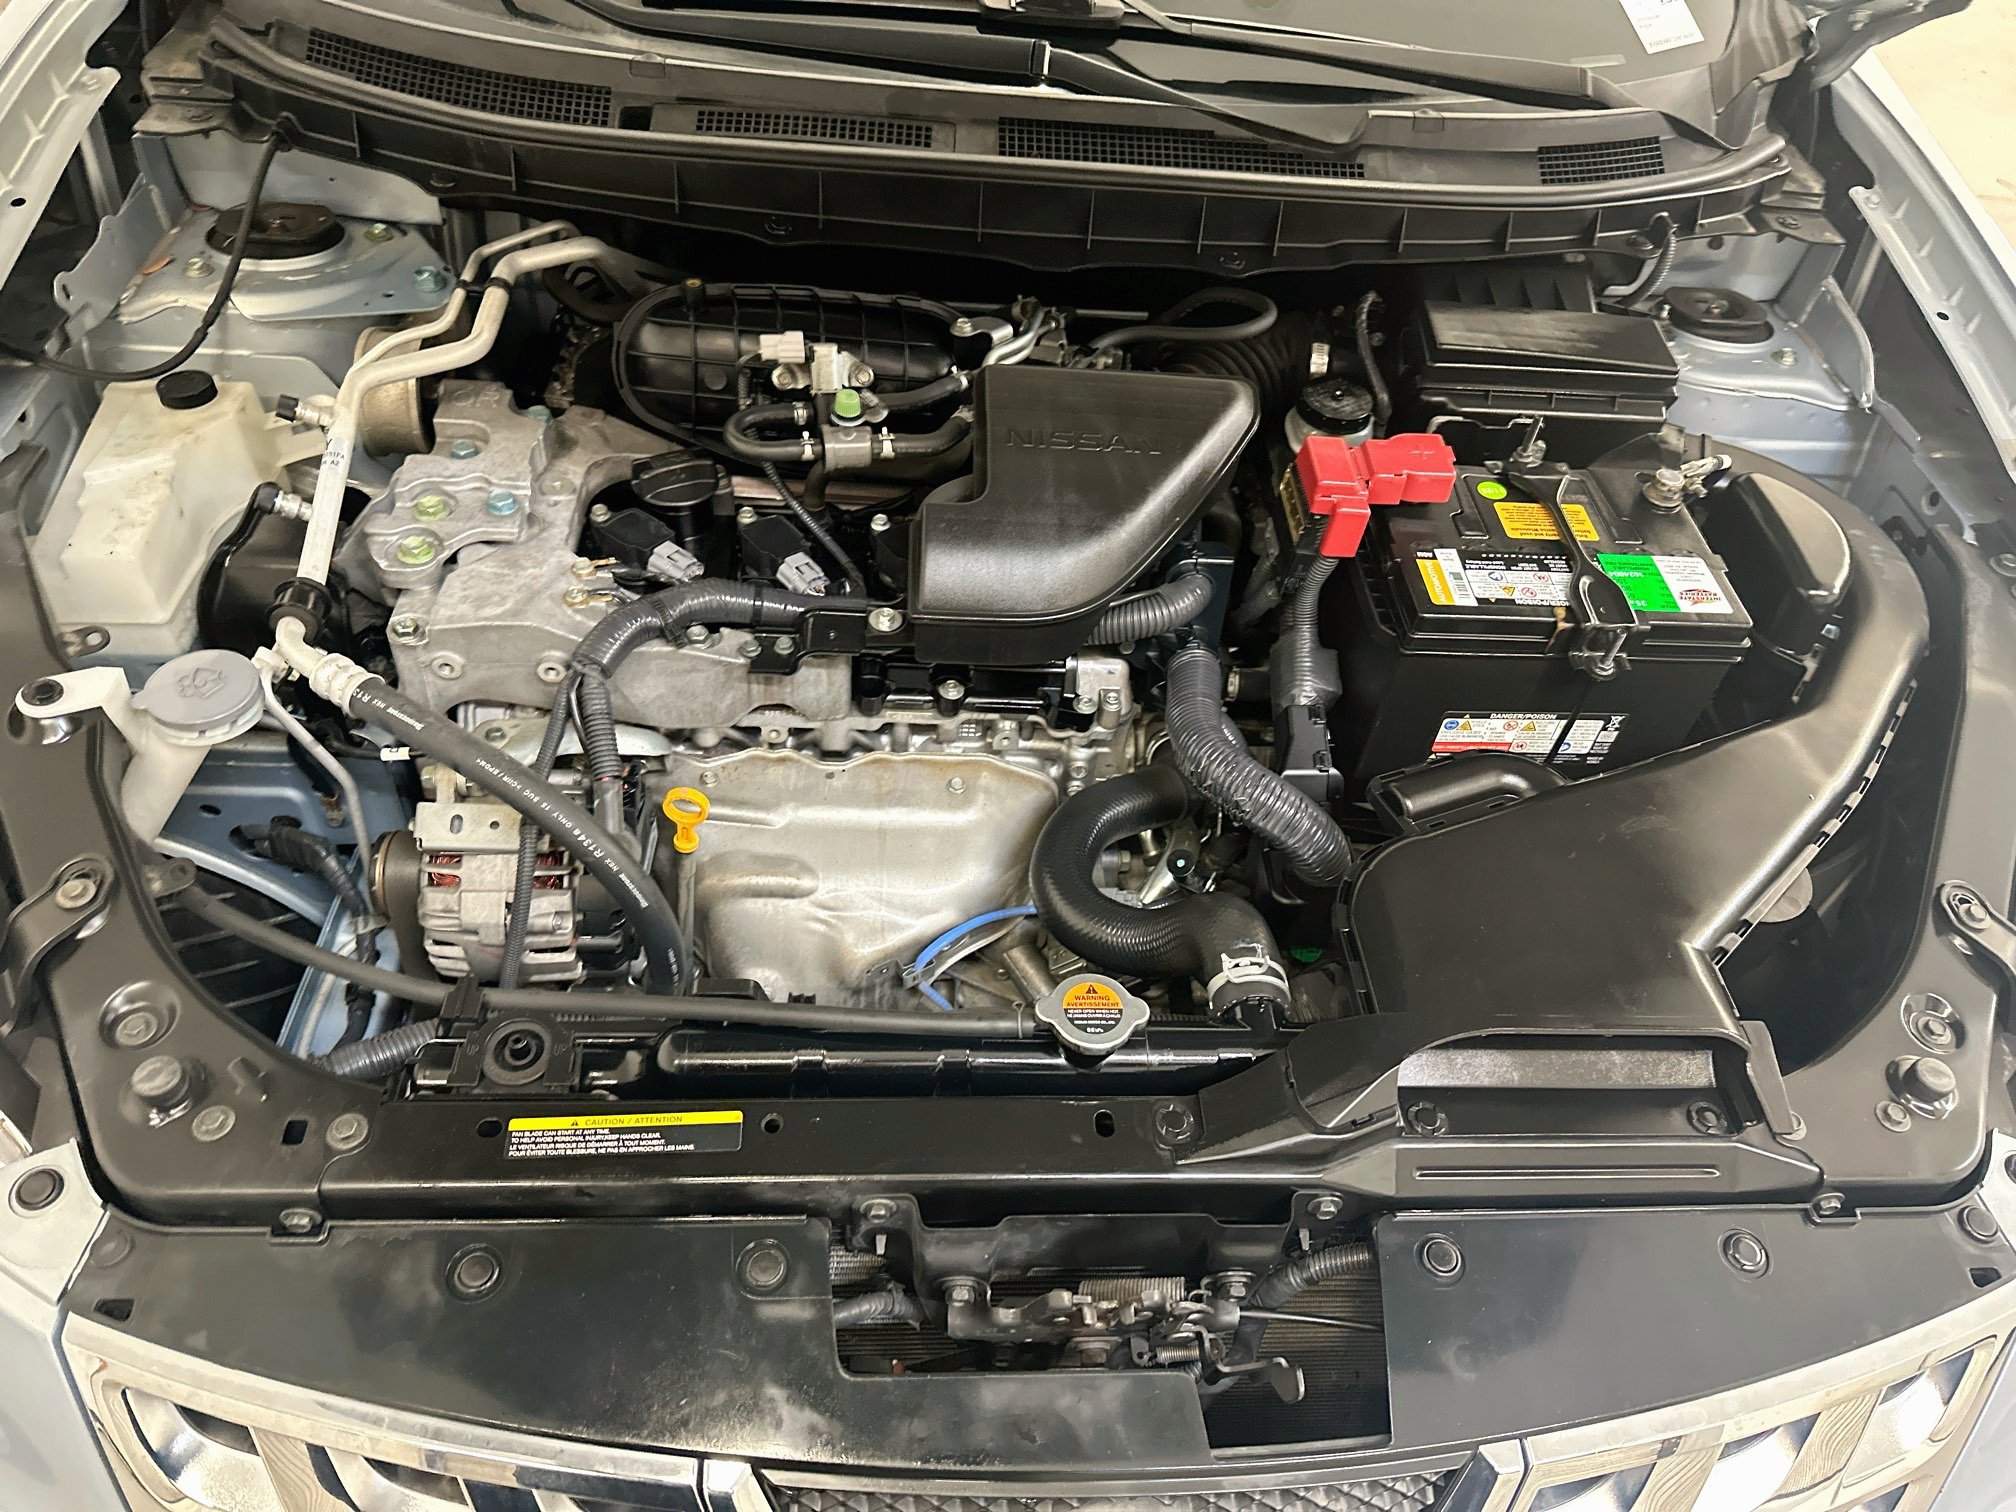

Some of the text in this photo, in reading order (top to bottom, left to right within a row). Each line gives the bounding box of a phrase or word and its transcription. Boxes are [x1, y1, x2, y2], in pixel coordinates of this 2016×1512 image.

[1007, 428, 1161, 455] NISSAN
[551, 811, 573, 829] ONLY
[572, 827, 605, 859] R134a
[585, 1118, 624, 1126] CAUTION
[635, 1115, 683, 1124] ATTENTION
